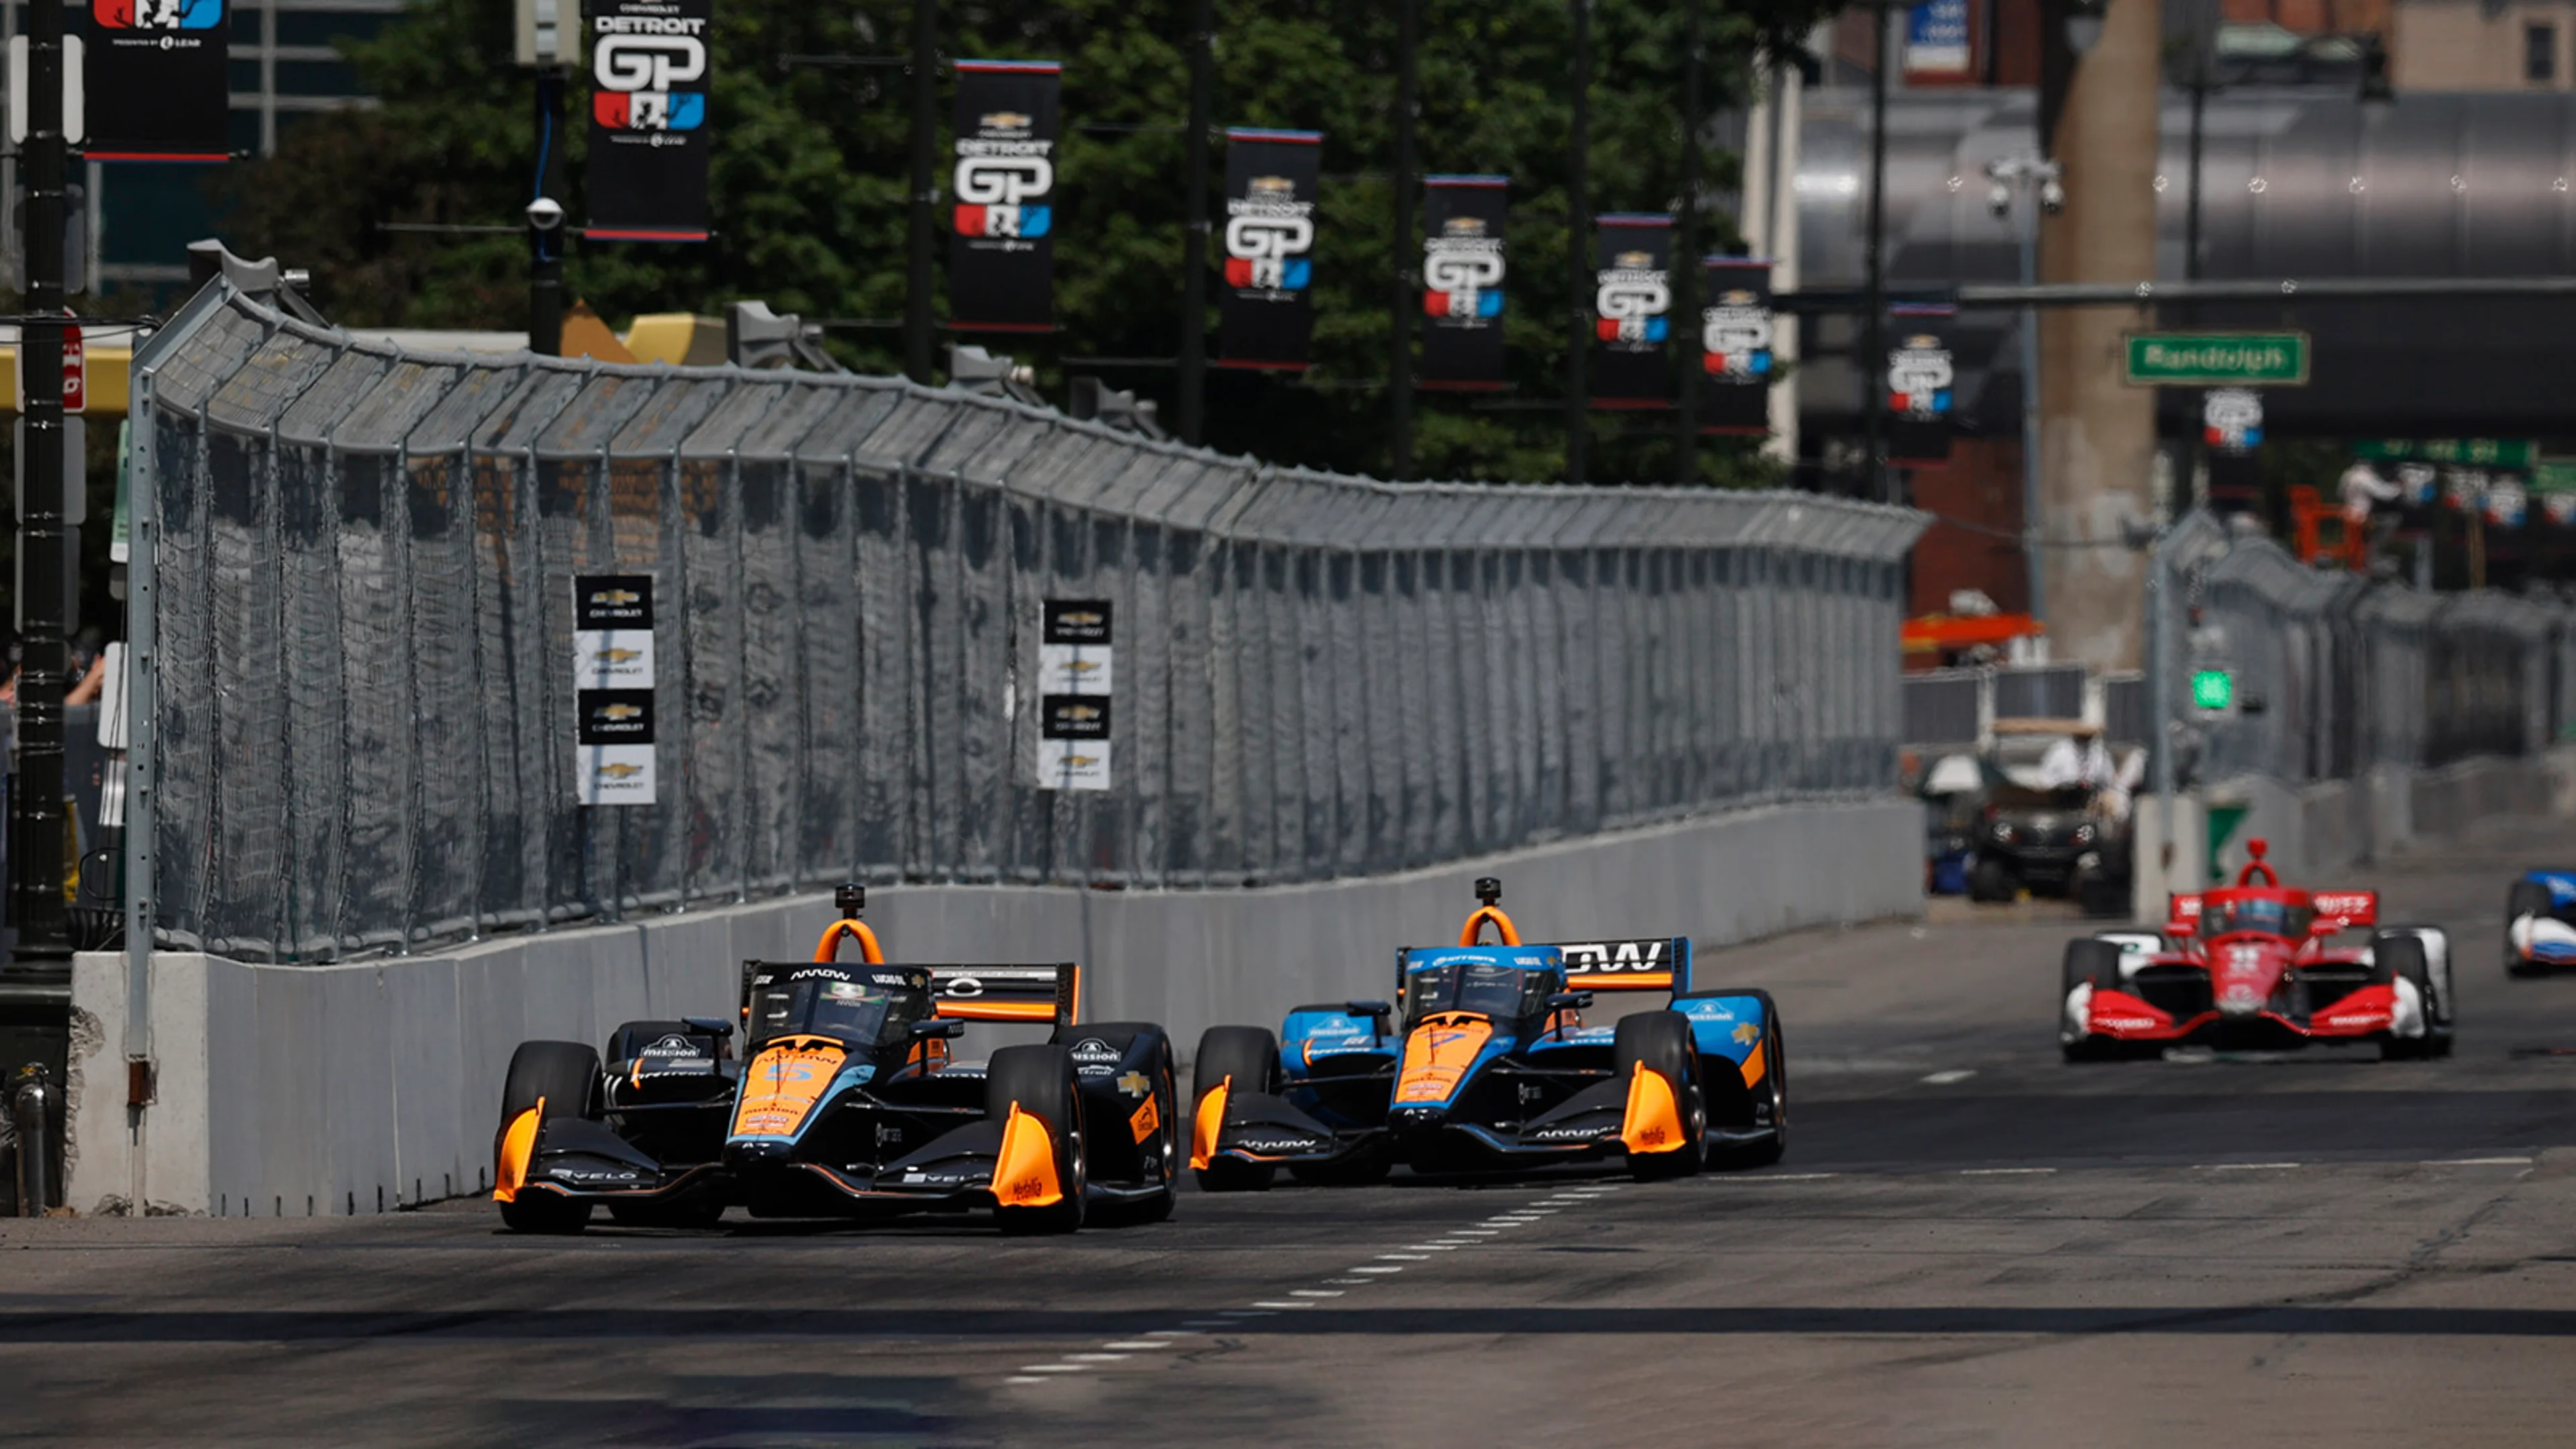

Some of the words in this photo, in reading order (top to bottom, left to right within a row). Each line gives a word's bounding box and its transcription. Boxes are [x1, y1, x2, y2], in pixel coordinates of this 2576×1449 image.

[595, 16, 705, 34] DETROIT
[594, 34, 706, 92] GP
[956, 138, 1053, 155] DETROIT
[954, 156, 1053, 205] GP
[1226, 217, 1313, 259] GP
[1424, 251, 1505, 291] GP
[2145, 344, 2288, 373] Randolph
[590, 608, 642, 618] CHEVROLET
[592, 723, 644, 731] CHEVROLET
[791, 969, 851, 981] ARROW
[763, 1062, 814, 1081] 5
[1536, 1126, 1616, 1138] ARROW
